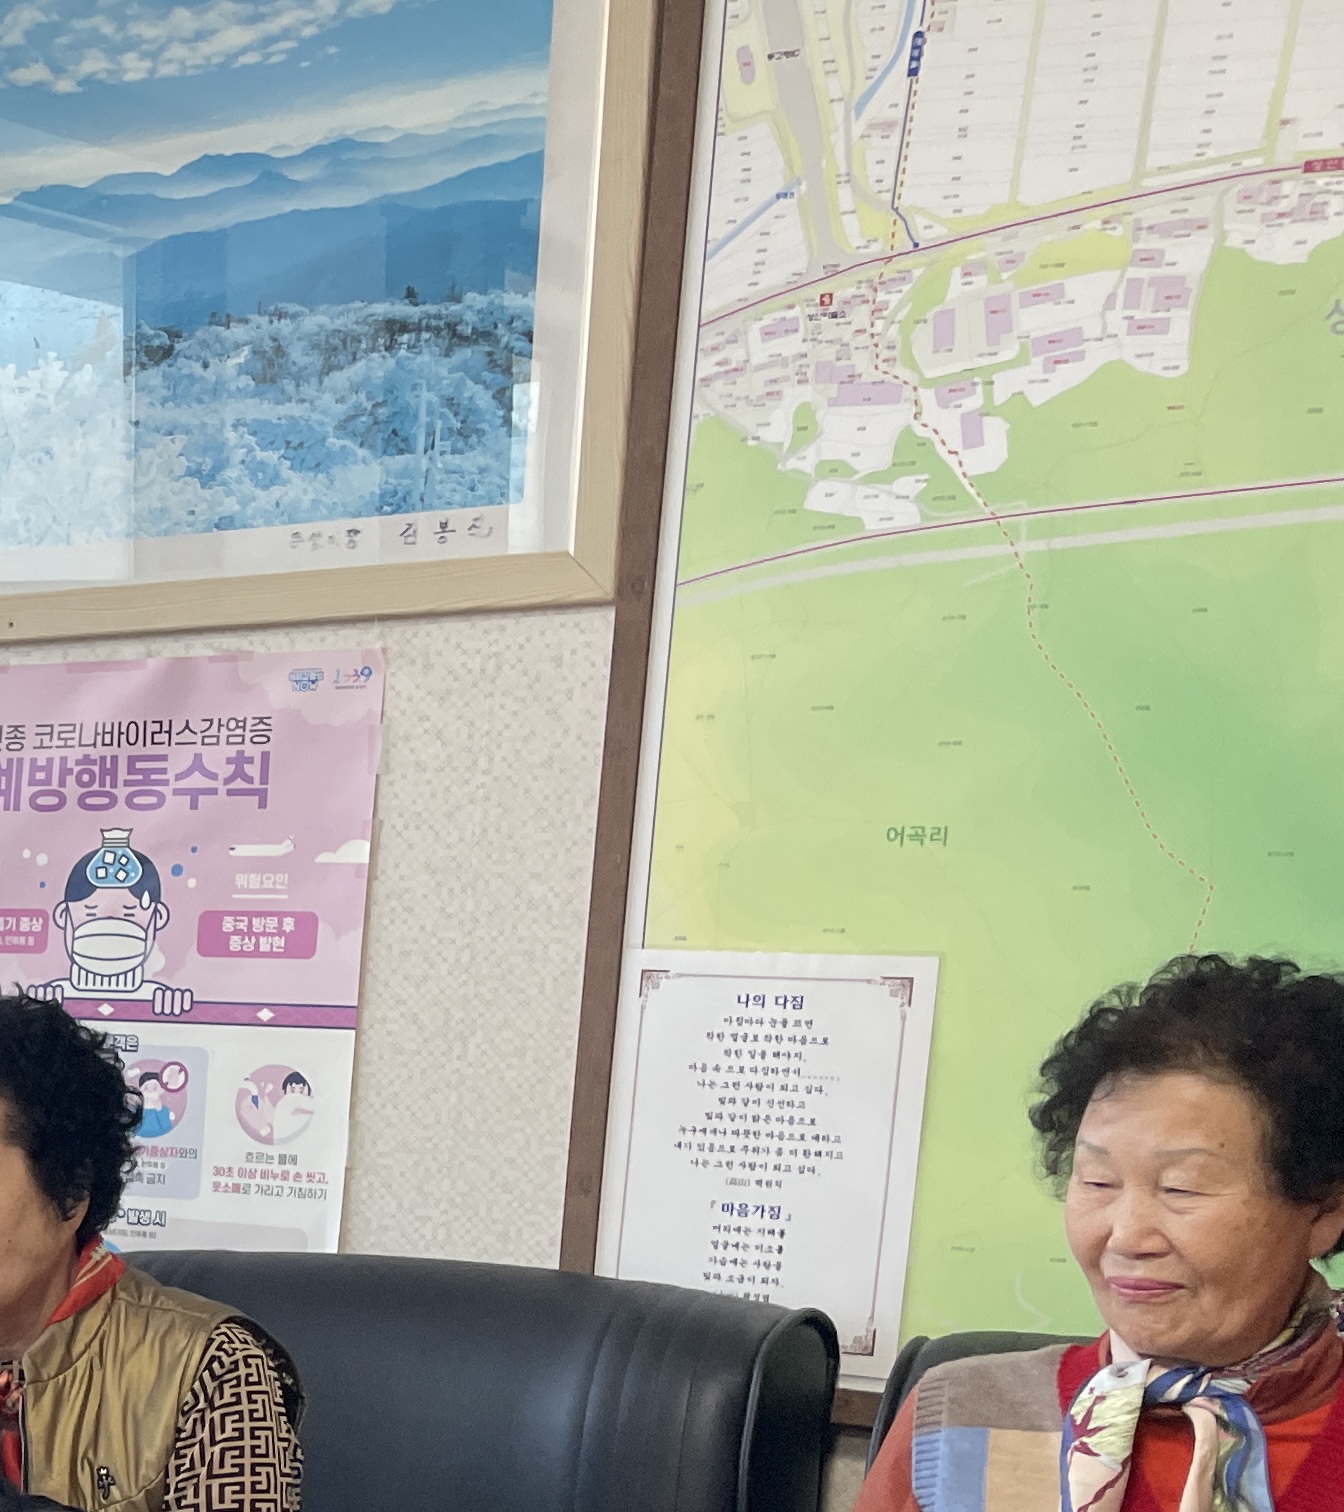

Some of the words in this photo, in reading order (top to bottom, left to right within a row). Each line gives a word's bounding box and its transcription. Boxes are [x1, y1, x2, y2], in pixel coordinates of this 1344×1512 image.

[32, 716, 273, 751] 코로나바이러스감염증
[886, 825, 948, 847] 어곡리
[235, 873, 288, 889] 위험요인
[19, 917, 43, 932] 증상
[222, 916, 248, 932] 중국
[252, 916, 278, 932] 방문
[229, 935, 256, 952] 증상
[259, 935, 285, 952] 발현
[737, 993, 766, 1009] 나의
[774, 994, 805, 1010] 다짐
[245, 1152, 274, 1164] 흐르는
[147, 1173, 166, 1185] 금지
[212, 1166, 234, 1178] 30초
[237, 1167, 258, 1180] 이상
[260, 1168, 290, 1181] 비누로
[293, 1171, 303, 1182] 손
[254, 1183, 284, 1198] 가리고
[287, 1186, 328, 1201] 기침하기
[127, 1208, 151, 1226] 발생
[153, 1210, 167, 1228] 시
